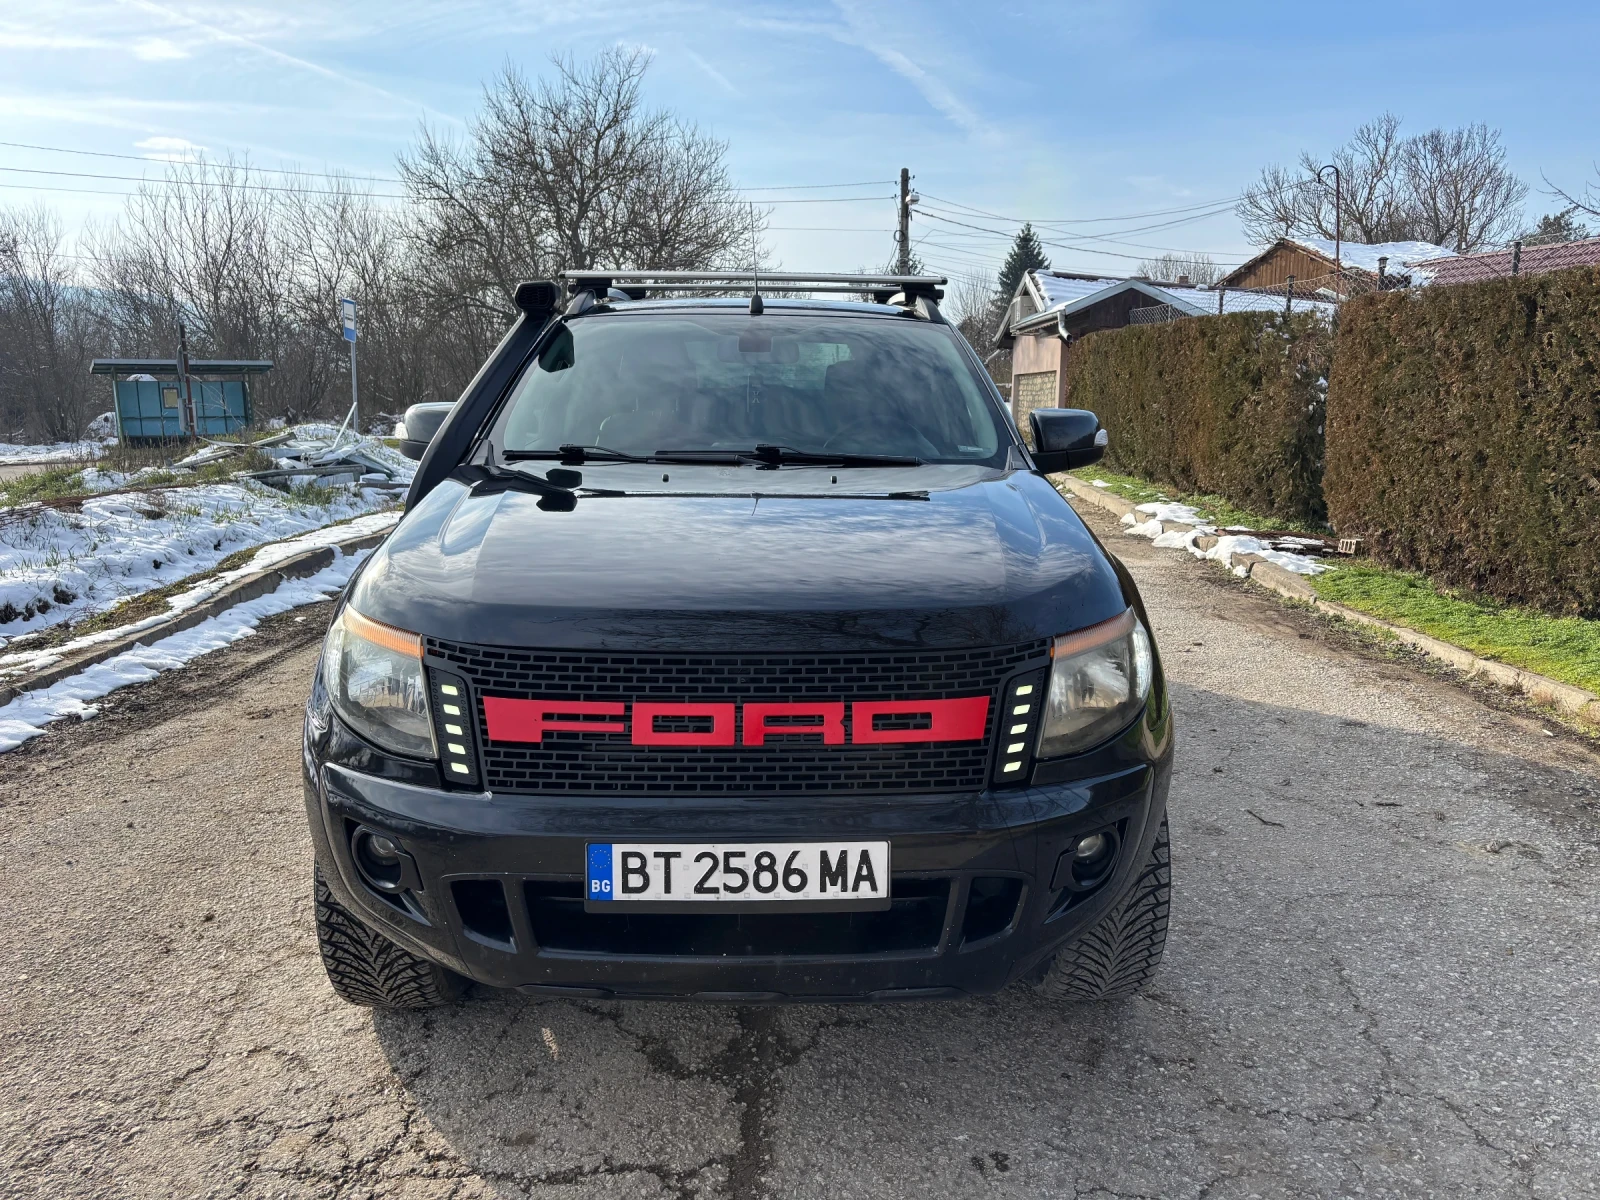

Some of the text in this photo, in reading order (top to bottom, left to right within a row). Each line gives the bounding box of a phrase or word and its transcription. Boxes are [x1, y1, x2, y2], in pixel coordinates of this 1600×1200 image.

[482, 696, 990, 746] FORD
[591, 879, 611, 893] BG
[620, 848, 878, 894] BT 2586 MA
